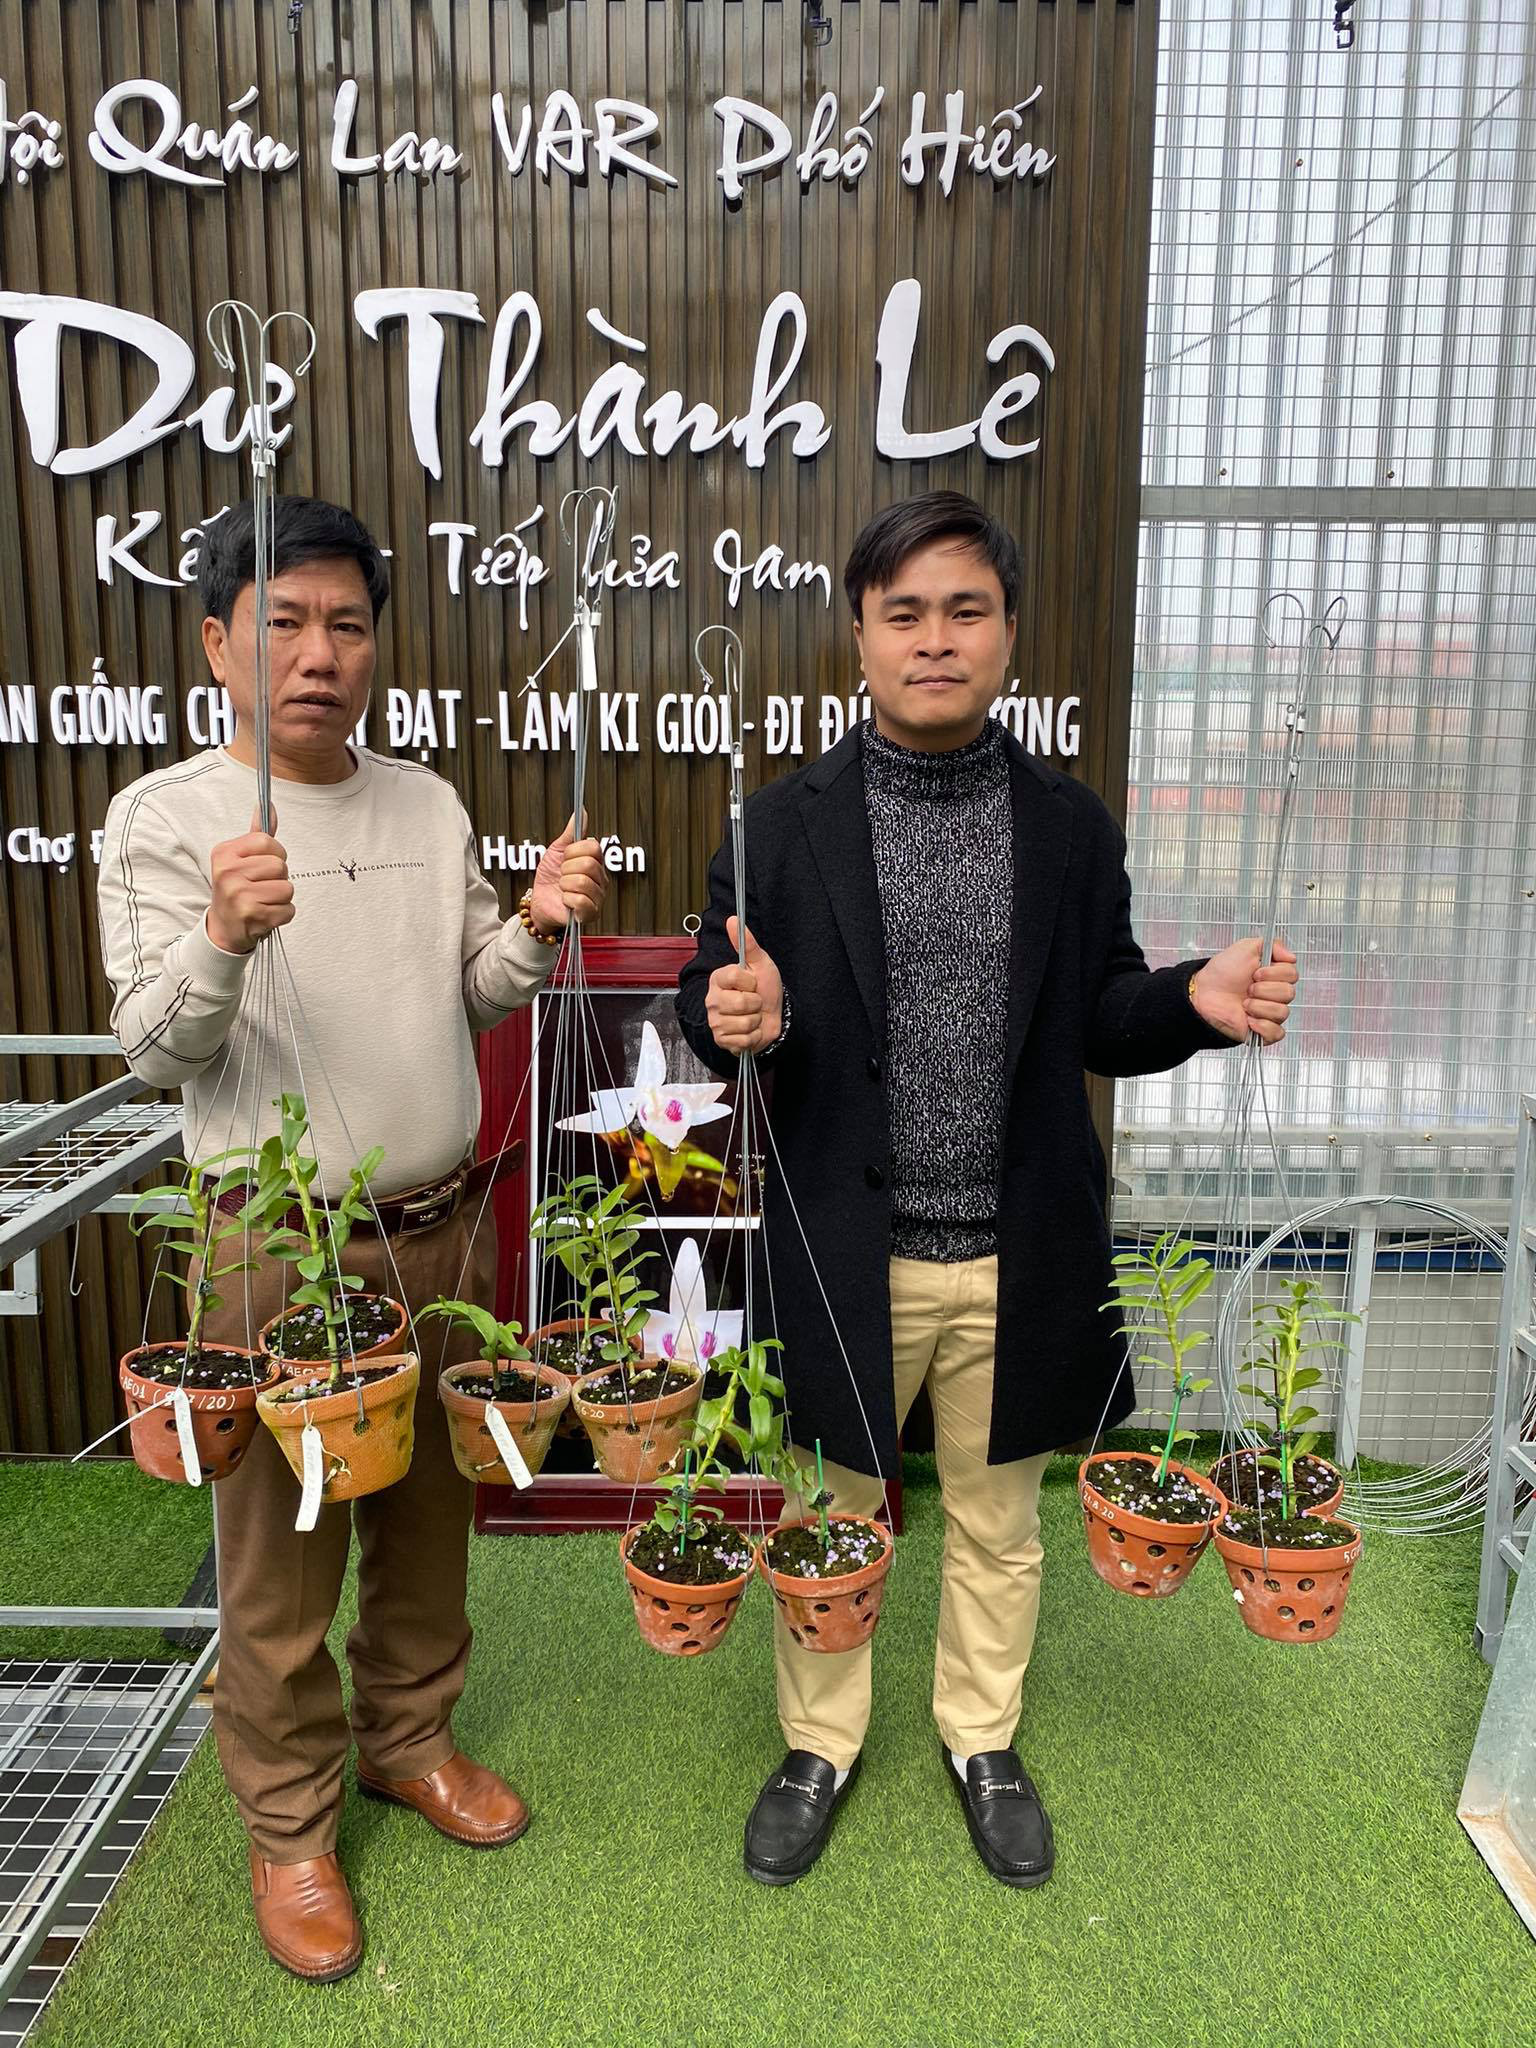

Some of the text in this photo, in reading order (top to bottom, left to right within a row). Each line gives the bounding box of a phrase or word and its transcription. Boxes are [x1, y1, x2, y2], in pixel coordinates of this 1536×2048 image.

[0, 78, 1058, 200] ội Quán Lan VAR Phố Hiến
[353, 287, 833, 482] Thành
[875, 278, 1056, 460] Lê
[428, 504, 550, 632] Tiếp
[50, 656, 168, 746] GIỐNG
[386, 687, 462, 762] ĐẠT
[764, 695, 805, 755] ĐI
[819, 679, 873, 755] ĐÚ
[7, 826, 76, 874] Chợ
[482, 835, 544, 872] Hưn
